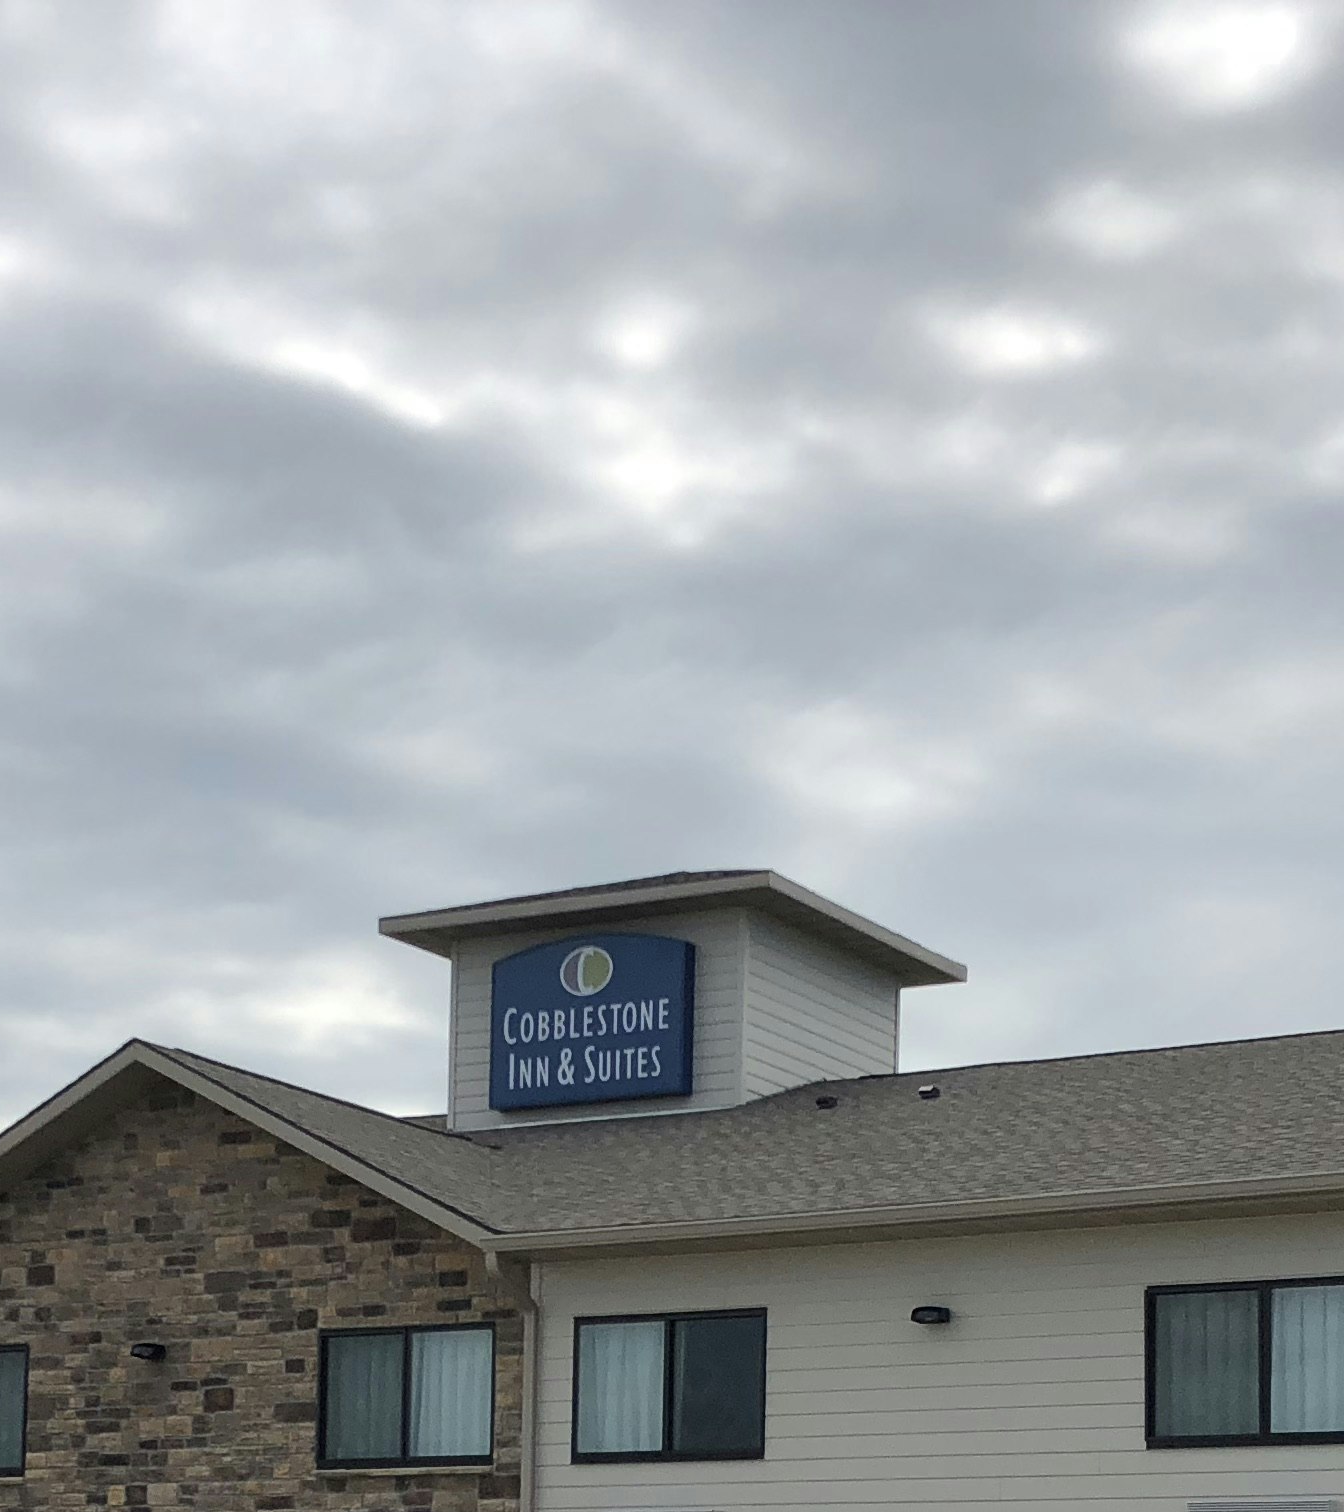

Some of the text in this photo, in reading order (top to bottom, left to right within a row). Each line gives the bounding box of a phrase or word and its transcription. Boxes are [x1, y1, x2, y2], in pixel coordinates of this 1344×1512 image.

[503, 998, 669, 1045] COBBLESTONE
[508, 1045, 661, 1090] INN & SUITES
